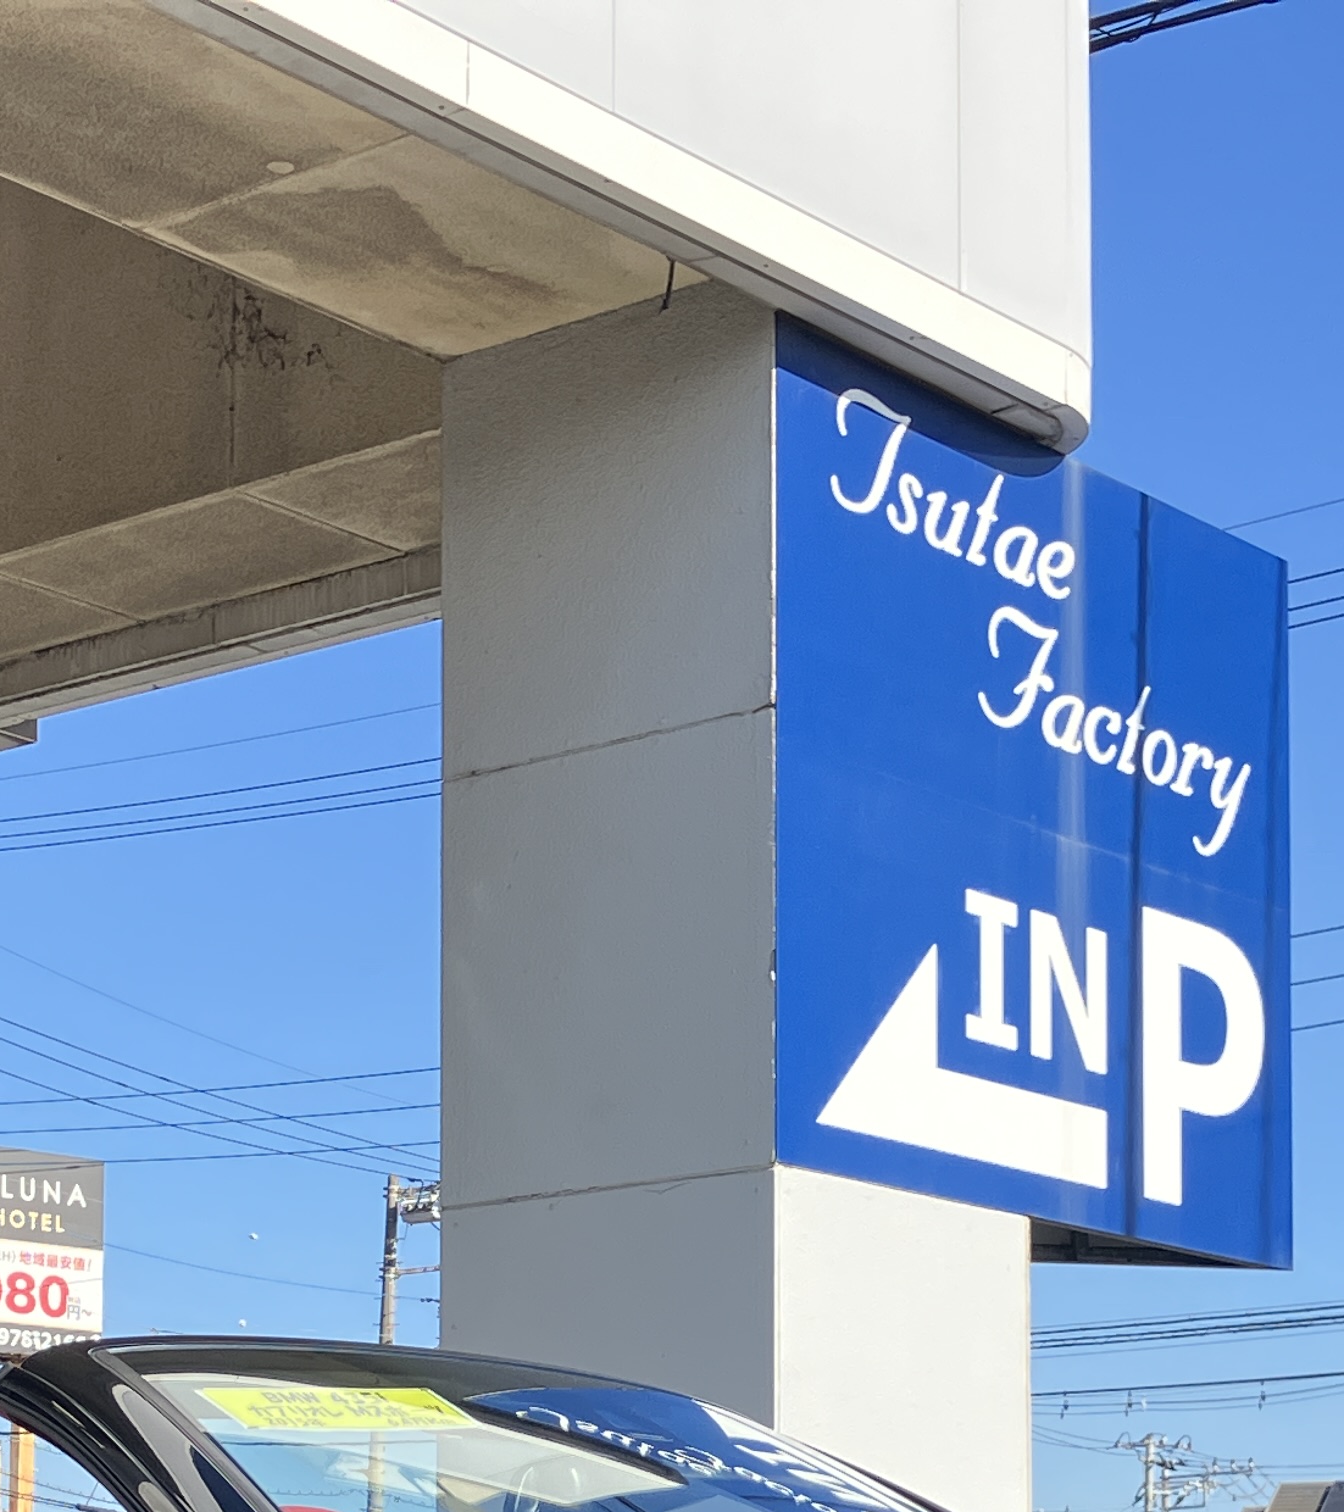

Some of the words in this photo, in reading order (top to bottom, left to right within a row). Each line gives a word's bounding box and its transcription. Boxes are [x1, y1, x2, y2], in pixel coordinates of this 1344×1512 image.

[829, 387, 1076, 601] Tsutae
[977, 605, 1252, 857] Factory
[964, 887, 1108, 1076] IN
[1141, 905, 1266, 1207] P
[0, 1173, 88, 1209] LUNA
[261, 1391, 321, 1404] BMW
